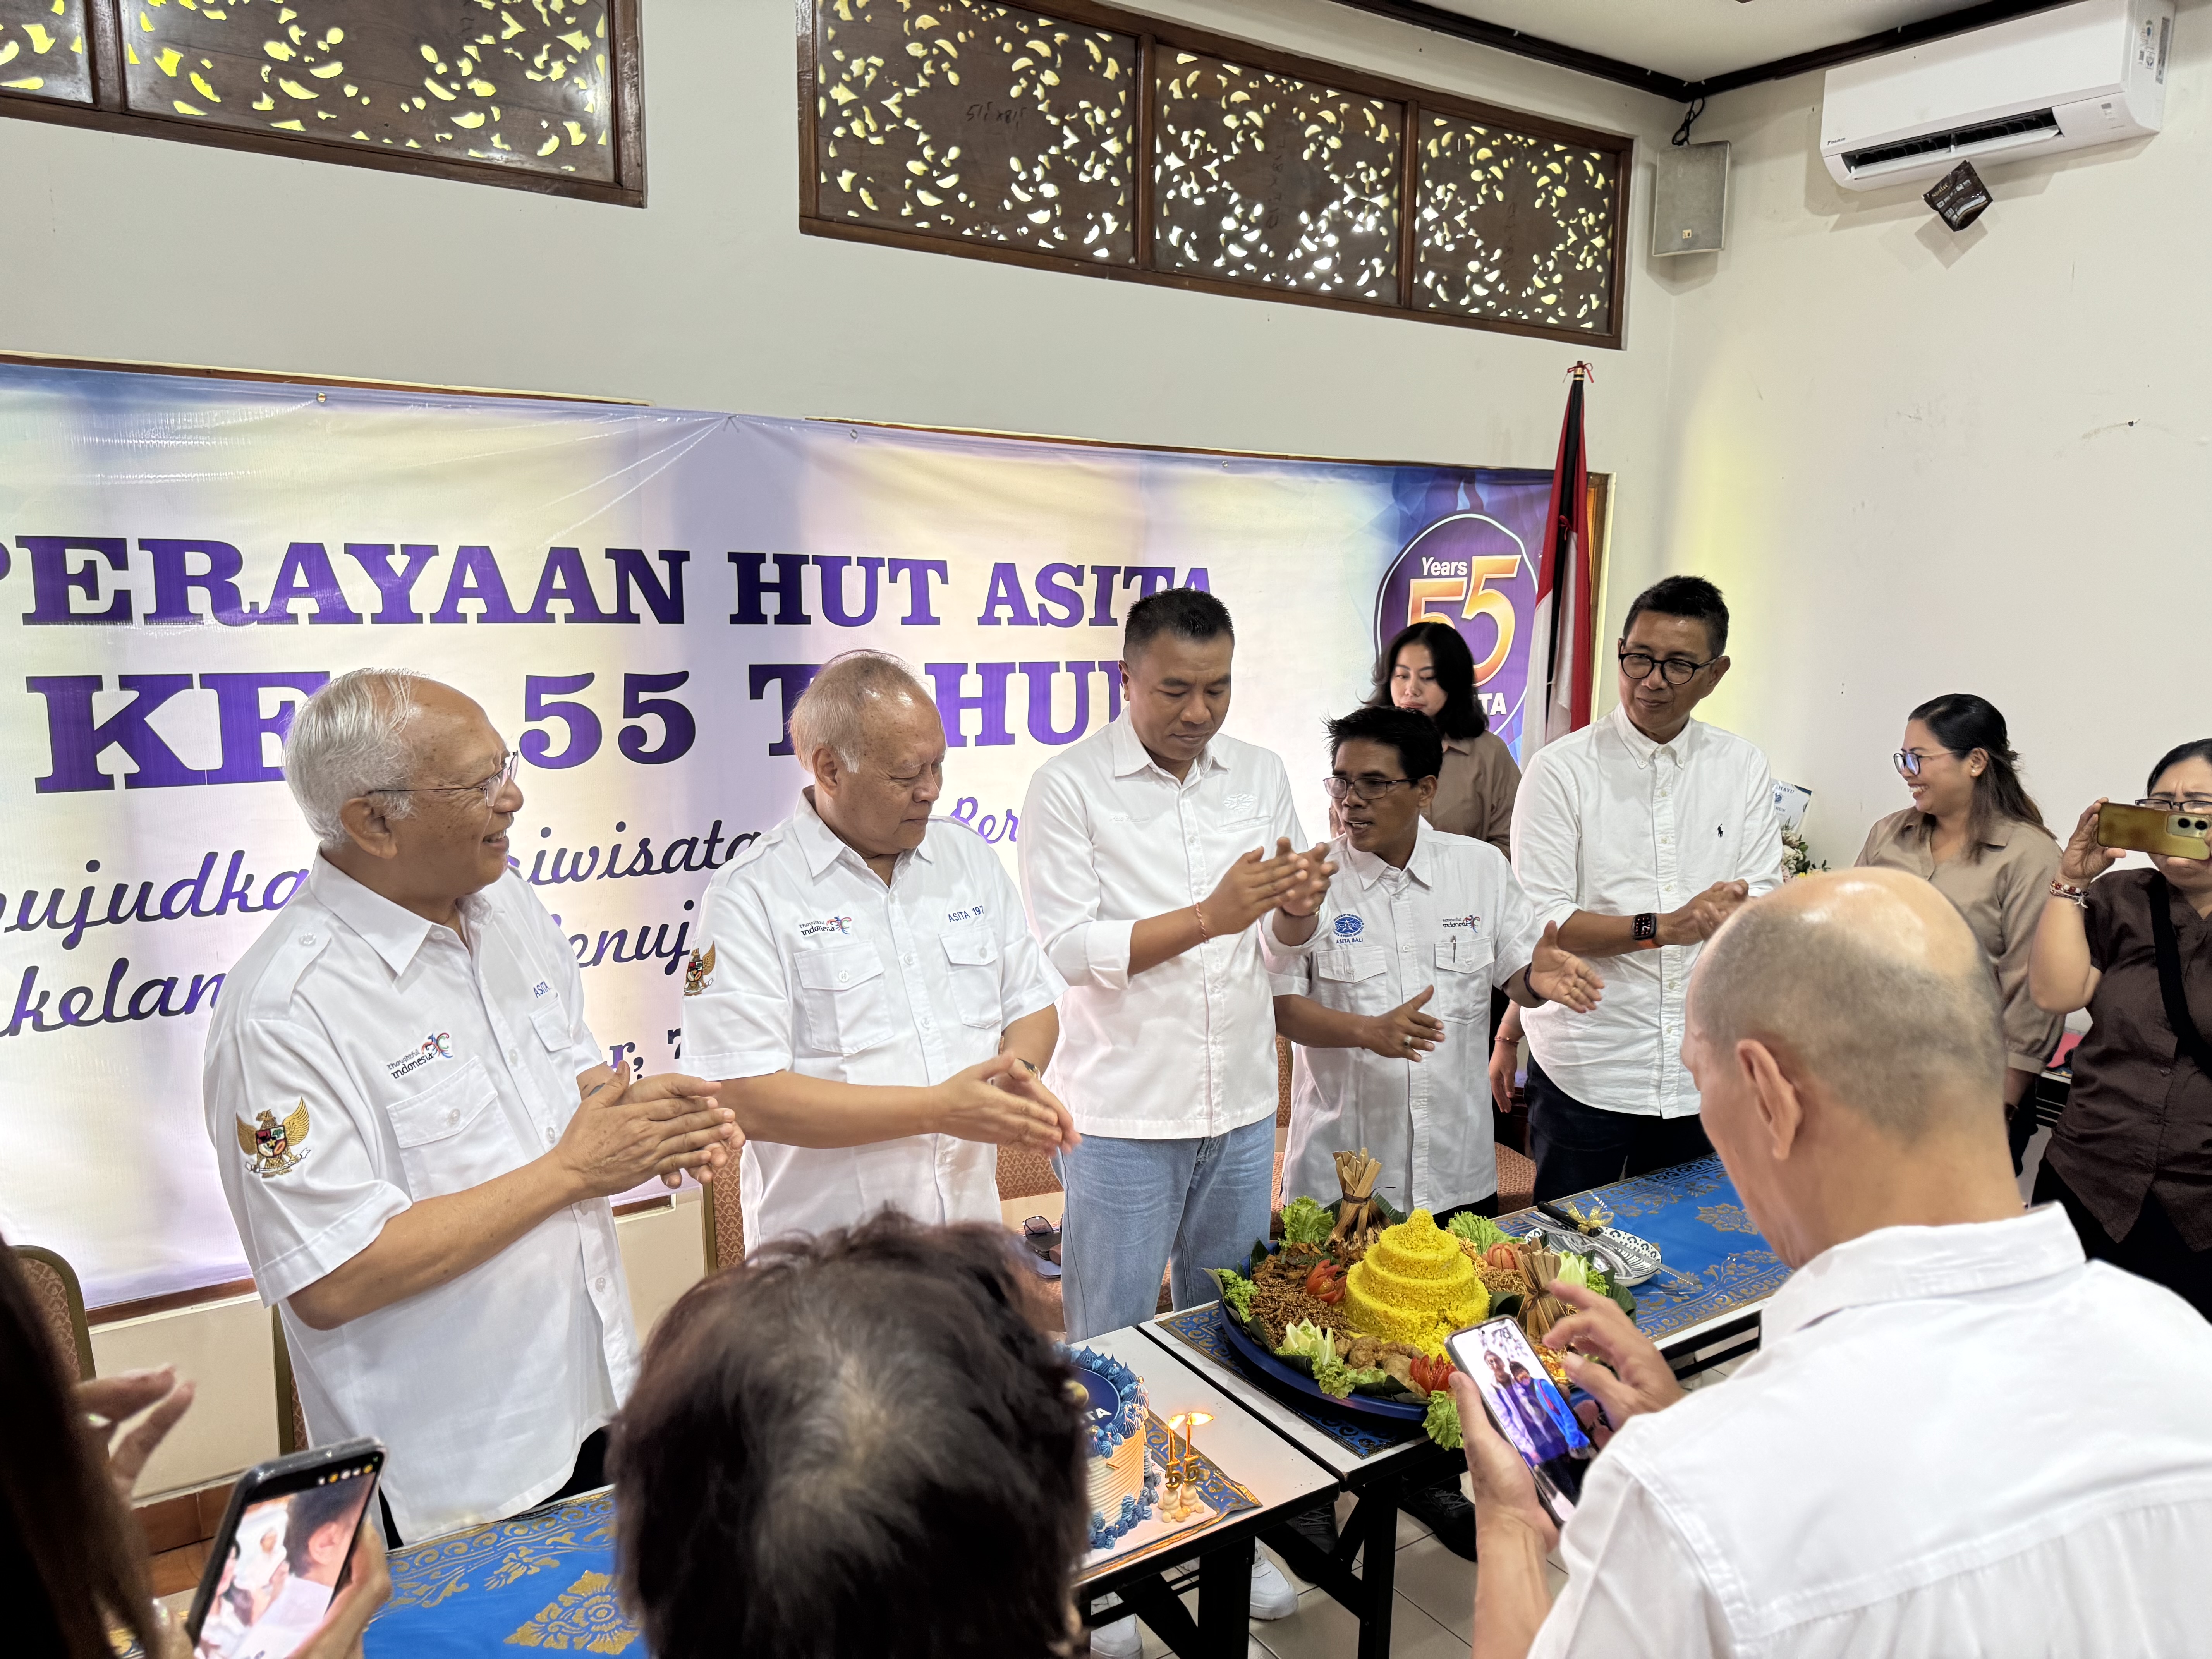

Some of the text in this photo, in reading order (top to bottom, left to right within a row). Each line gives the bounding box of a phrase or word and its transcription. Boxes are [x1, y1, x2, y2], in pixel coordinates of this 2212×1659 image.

[0, 535, 690, 627] ERAYAAN
[728, 552, 949, 627] HUT
[1422, 557, 1467, 576] Years
[26, 660, 1124, 794] KE 55 THU
[0, 850, 310, 950] ujudka
[508, 820, 761, 886] iwisata
[948, 905, 984, 922] ASITA 197
[551, 900, 691, 975] enuj
[391, 1052, 434, 1079] indonesia
